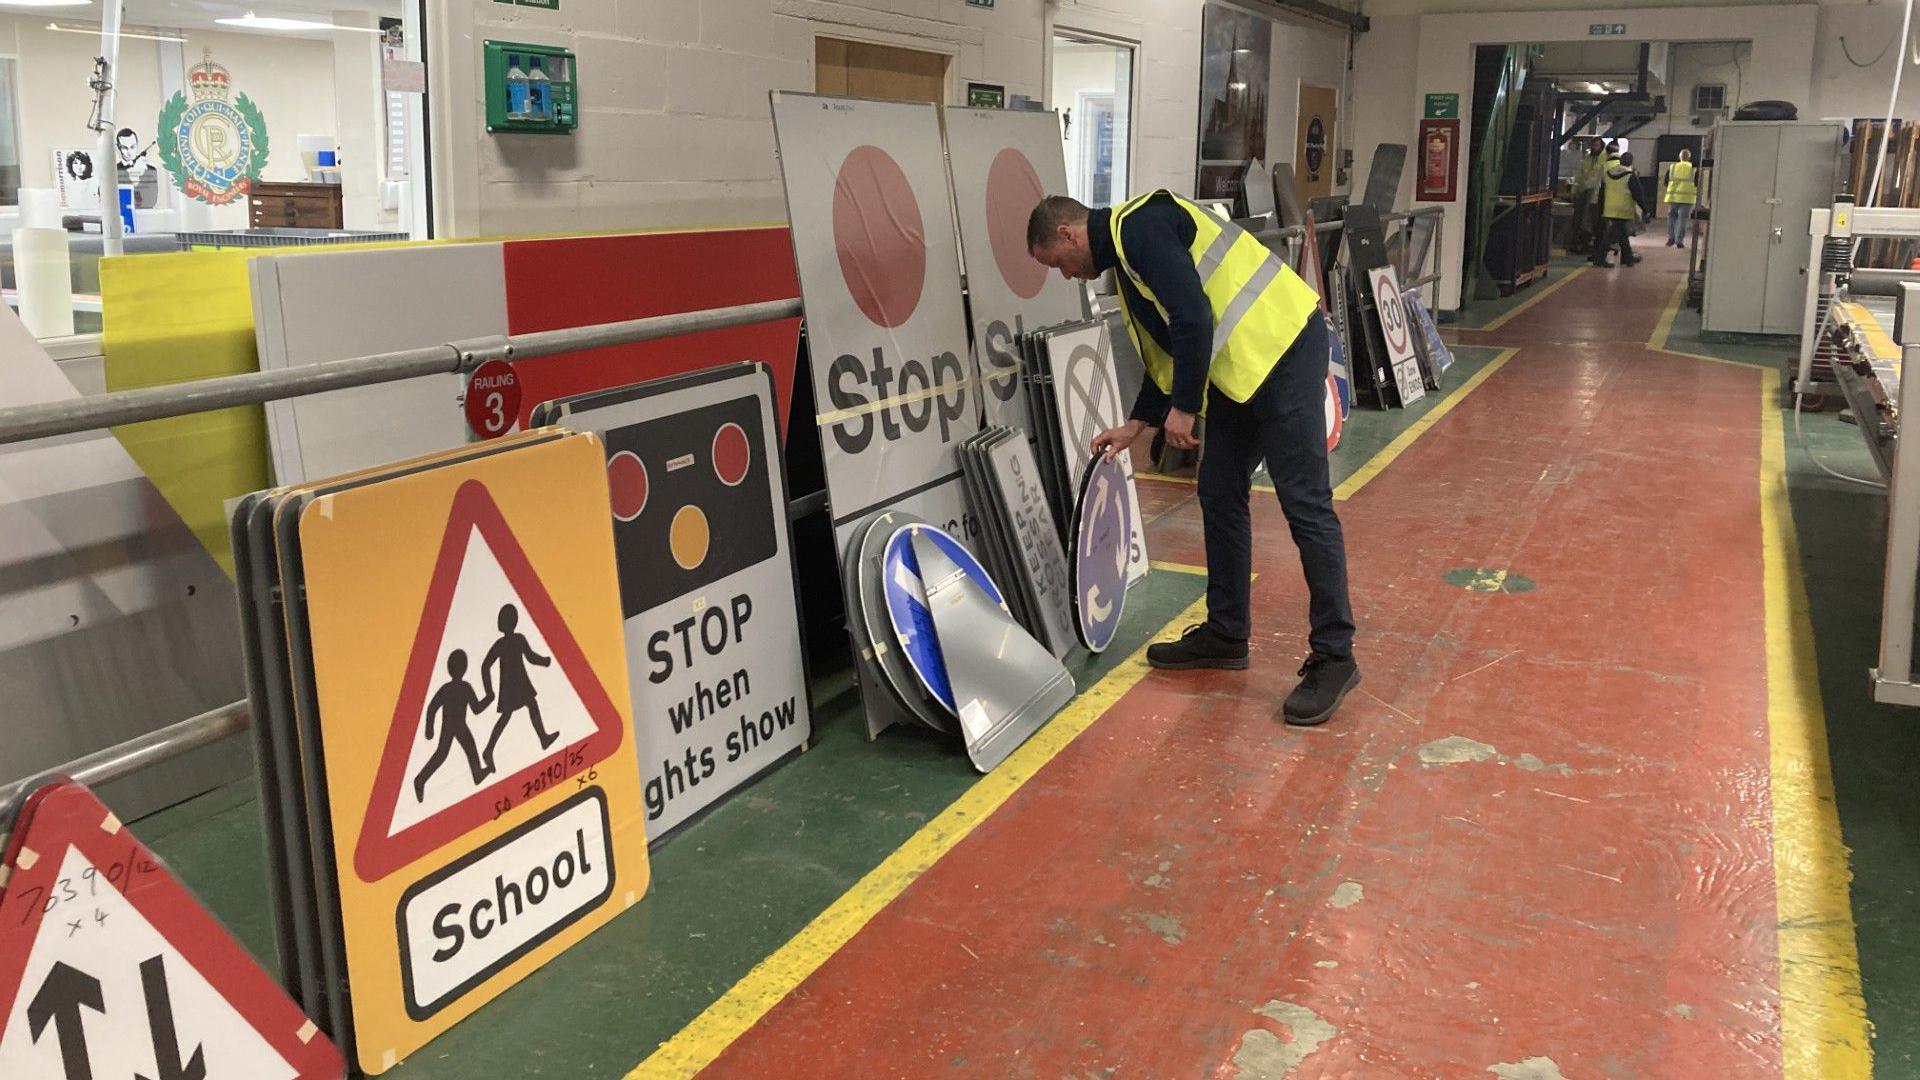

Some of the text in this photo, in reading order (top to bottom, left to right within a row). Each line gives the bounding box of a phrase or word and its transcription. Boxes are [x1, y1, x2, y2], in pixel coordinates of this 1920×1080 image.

[1382, 297, 1403, 332] 30
[474, 373, 514, 391] RAILING
[485, 392, 504, 432] 3
[828, 347, 965, 454] Stop
[1014, 508, 1048, 595] KEEP
[647, 593, 752, 684] STOP
[668, 668, 750, 734] when
[644, 696, 796, 821] ghts show
[431, 830, 593, 963] School
